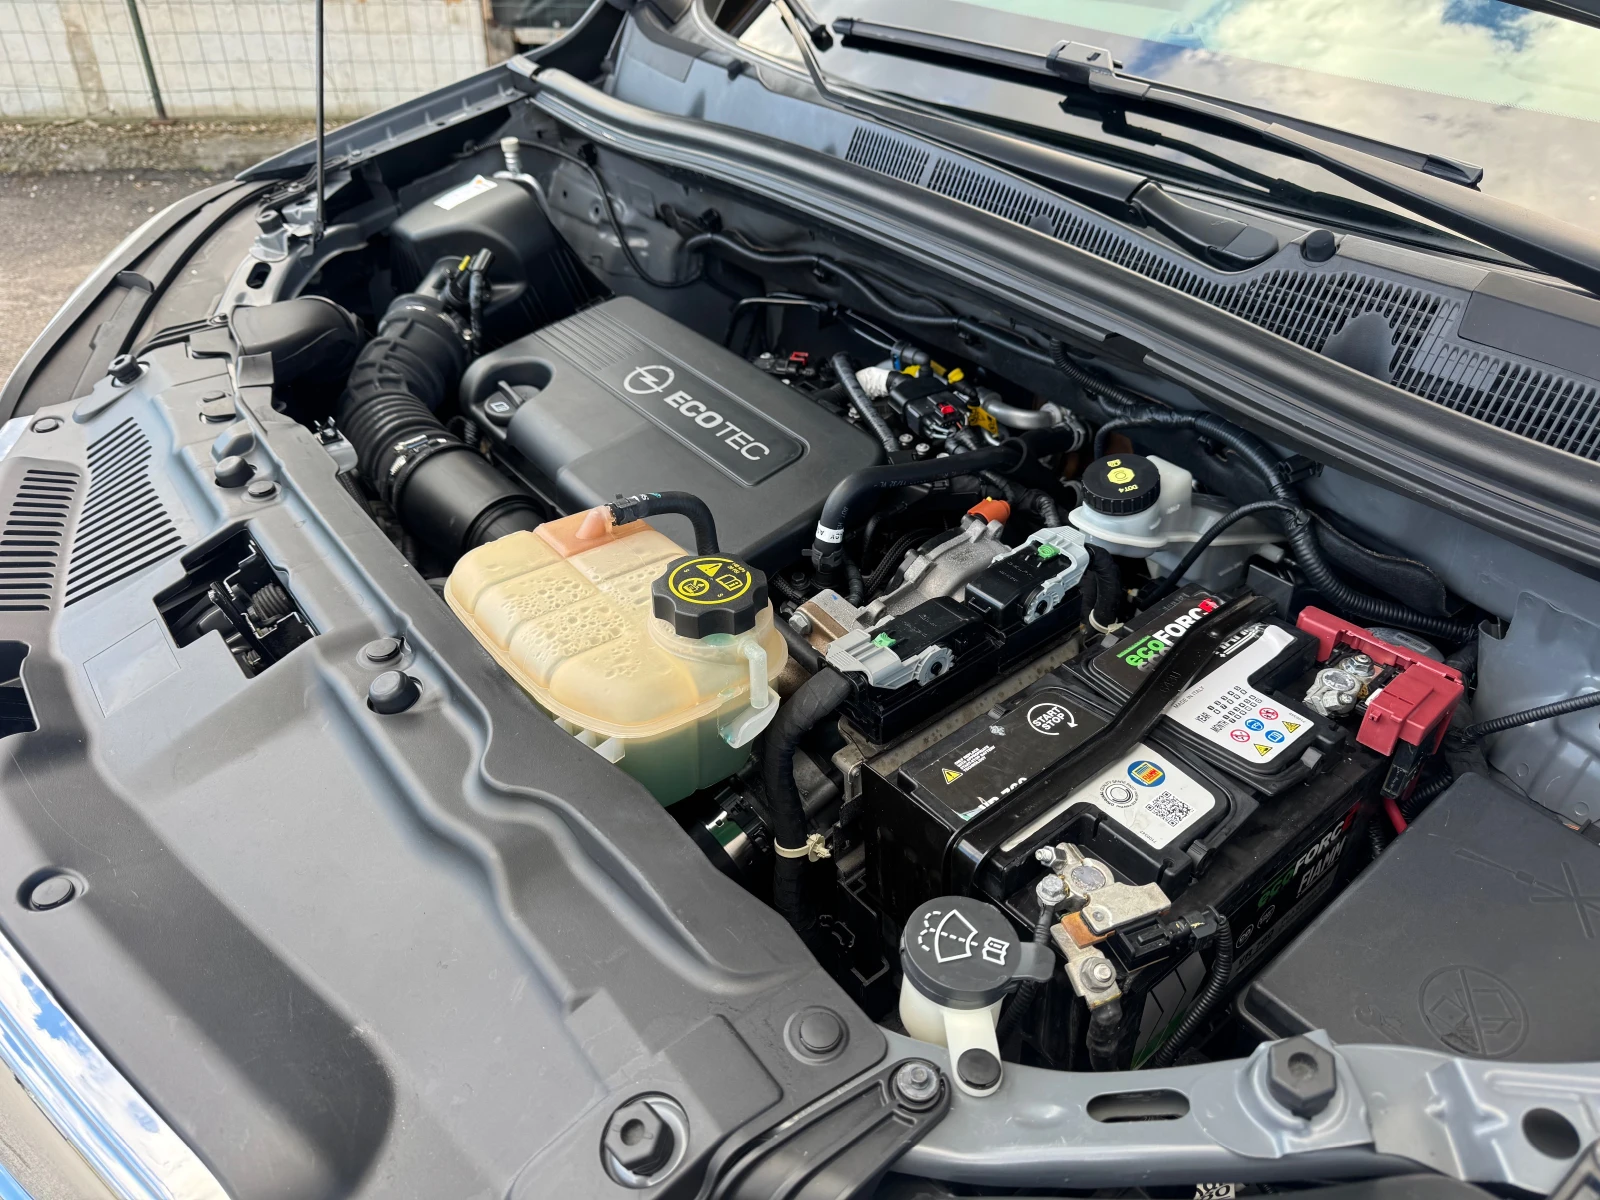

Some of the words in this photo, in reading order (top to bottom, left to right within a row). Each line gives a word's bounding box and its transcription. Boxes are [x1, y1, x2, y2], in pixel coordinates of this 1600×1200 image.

[664, 390, 770, 461] ECOTEC
[1124, 484, 1139, 492] DOT
[1032, 706, 1061, 727] START
[1041, 712, 1065, 730] STOP
[1195, 712, 1212, 723] YEAR
[1210, 720, 1229, 733] MONTH
[1297, 835, 1347, 893] FIAMM
